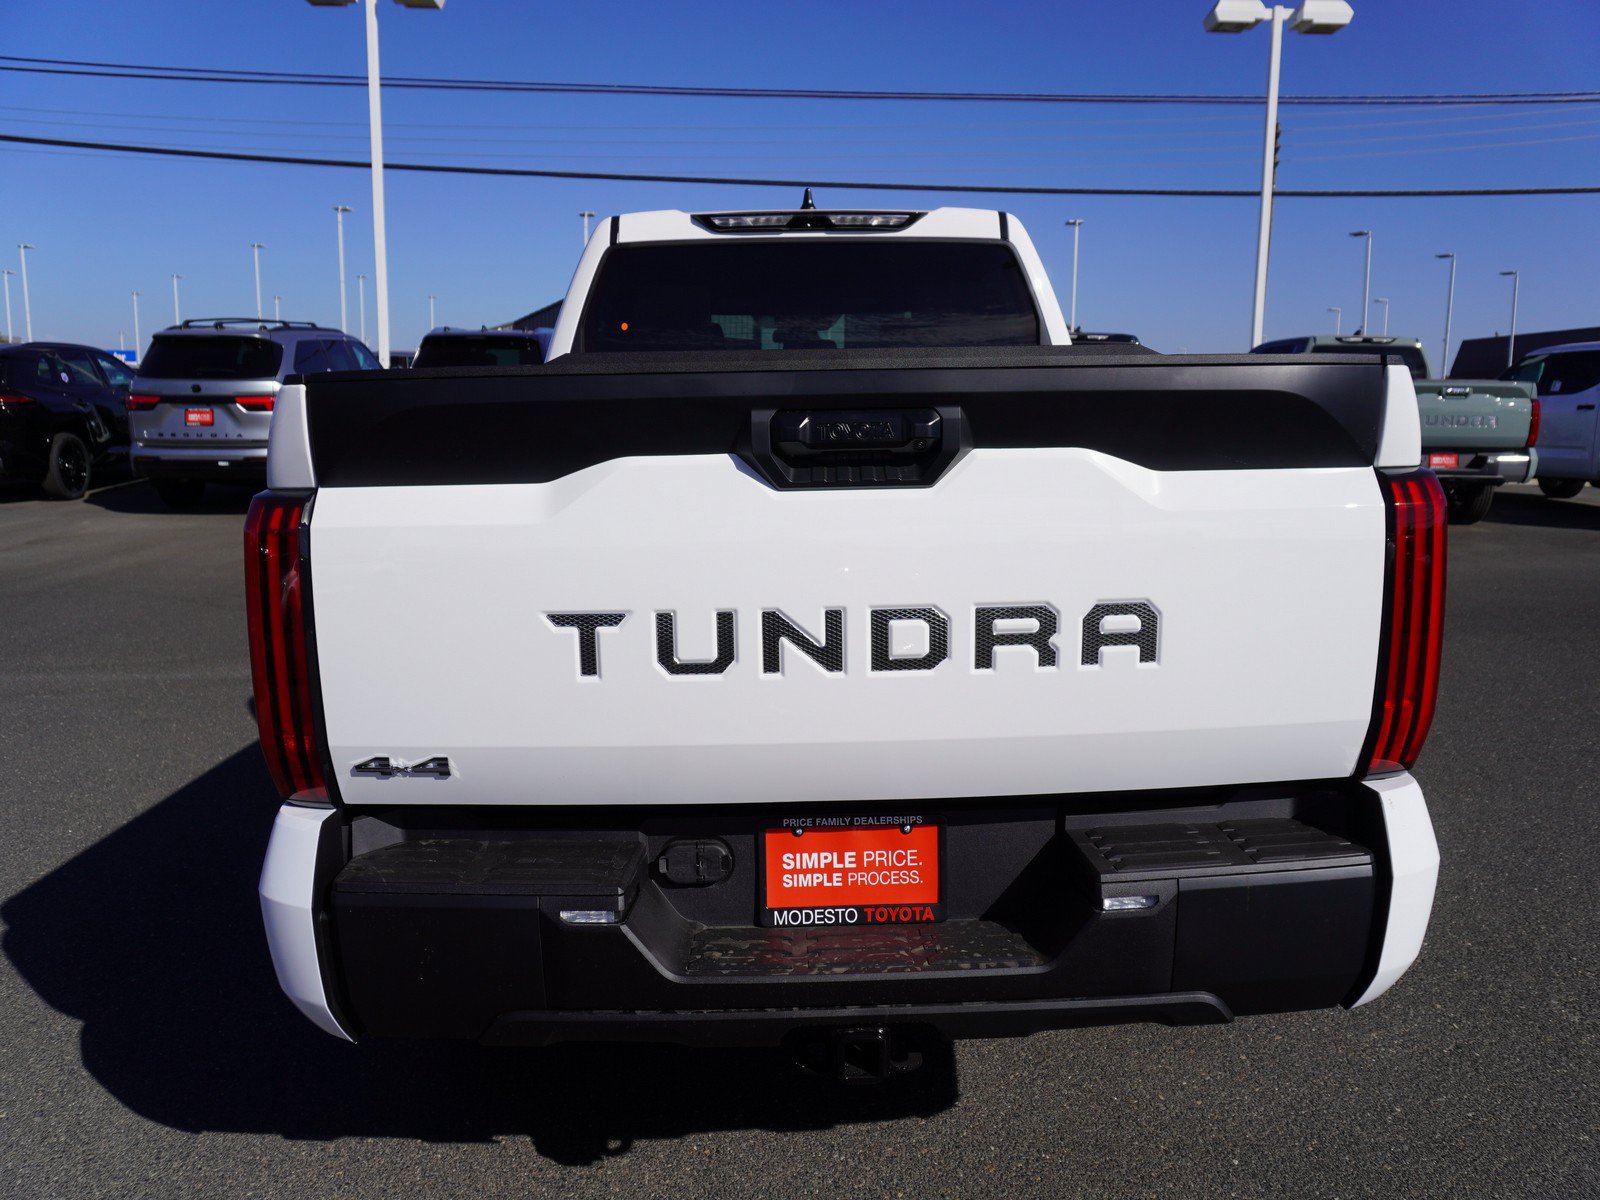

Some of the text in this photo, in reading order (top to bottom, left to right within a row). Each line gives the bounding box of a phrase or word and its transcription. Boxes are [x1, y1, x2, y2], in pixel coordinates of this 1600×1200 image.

[1424, 414, 1499, 428] UNDRA
[817, 422, 895, 441] TOYOTA
[543, 600, 1161, 679] TUNDRA
[783, 815, 923, 828] PRICE FAMILY DEALERSHIPS
[782, 849, 923, 870] SIMPLE PRICE.
[782, 870, 924, 888] SIMPLE PROCESS.
[773, 906, 935, 926] MODESTO TOYOTA
